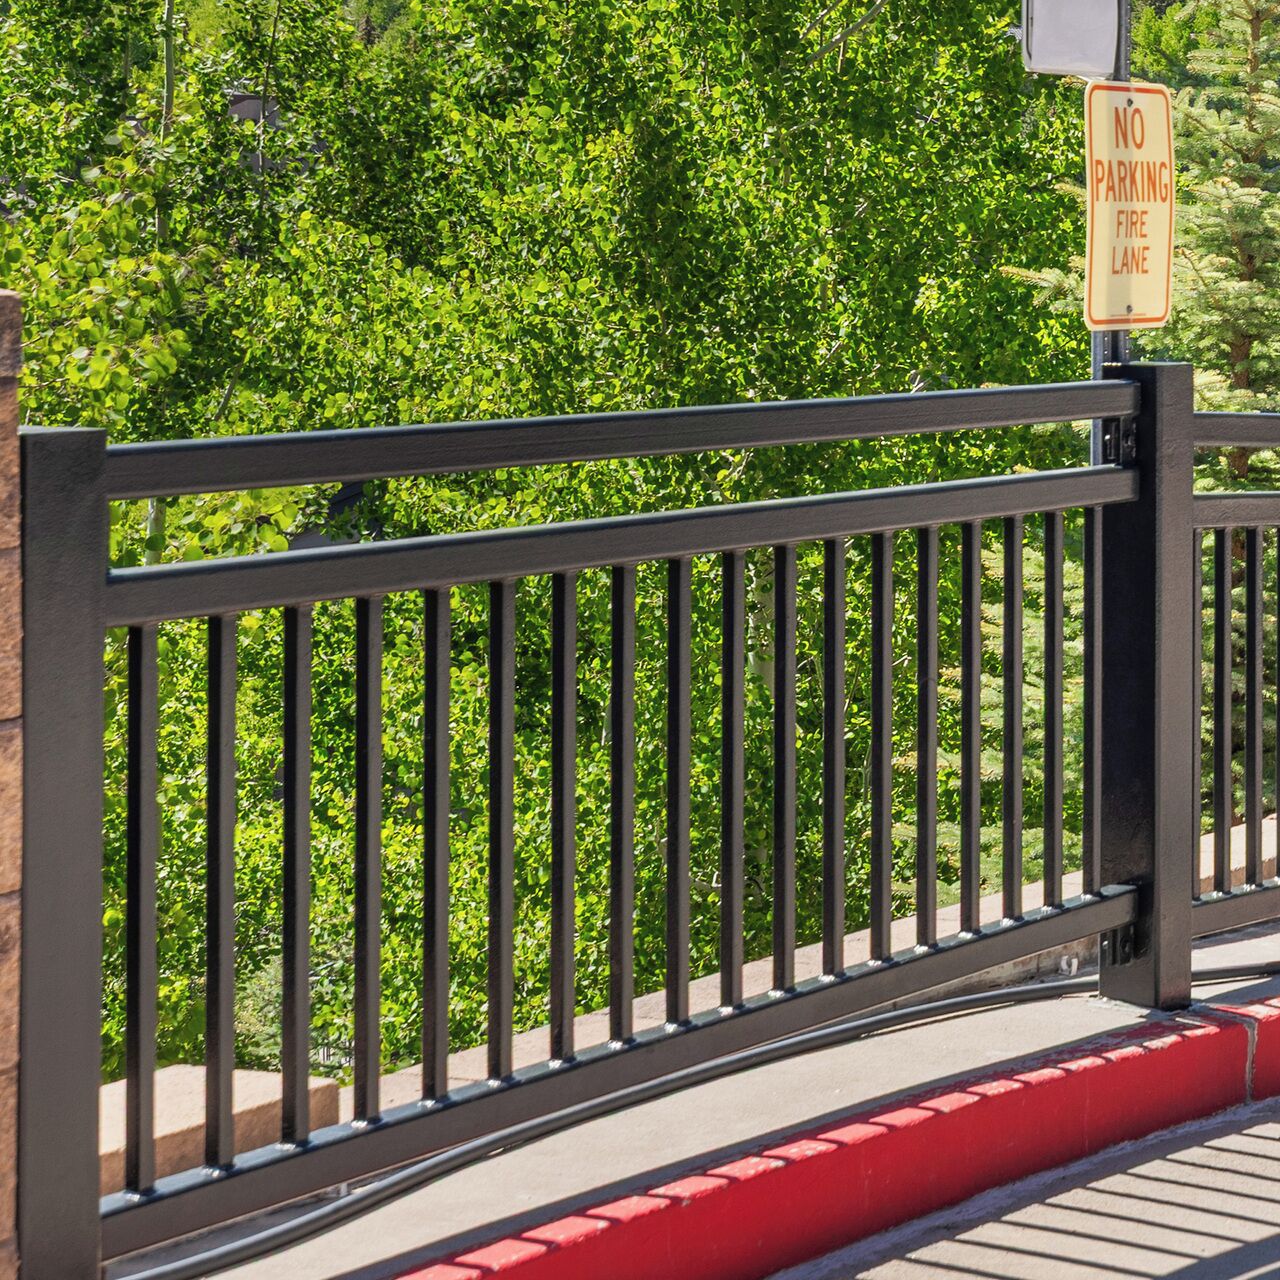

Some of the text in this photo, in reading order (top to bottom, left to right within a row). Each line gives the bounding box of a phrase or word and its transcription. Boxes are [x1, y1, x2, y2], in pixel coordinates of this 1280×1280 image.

[1114, 107, 1144, 150] NO
[1095, 159, 1168, 203] PARKING
[1117, 210, 1148, 239] FIRE
[1112, 246, 1150, 275] LANE
